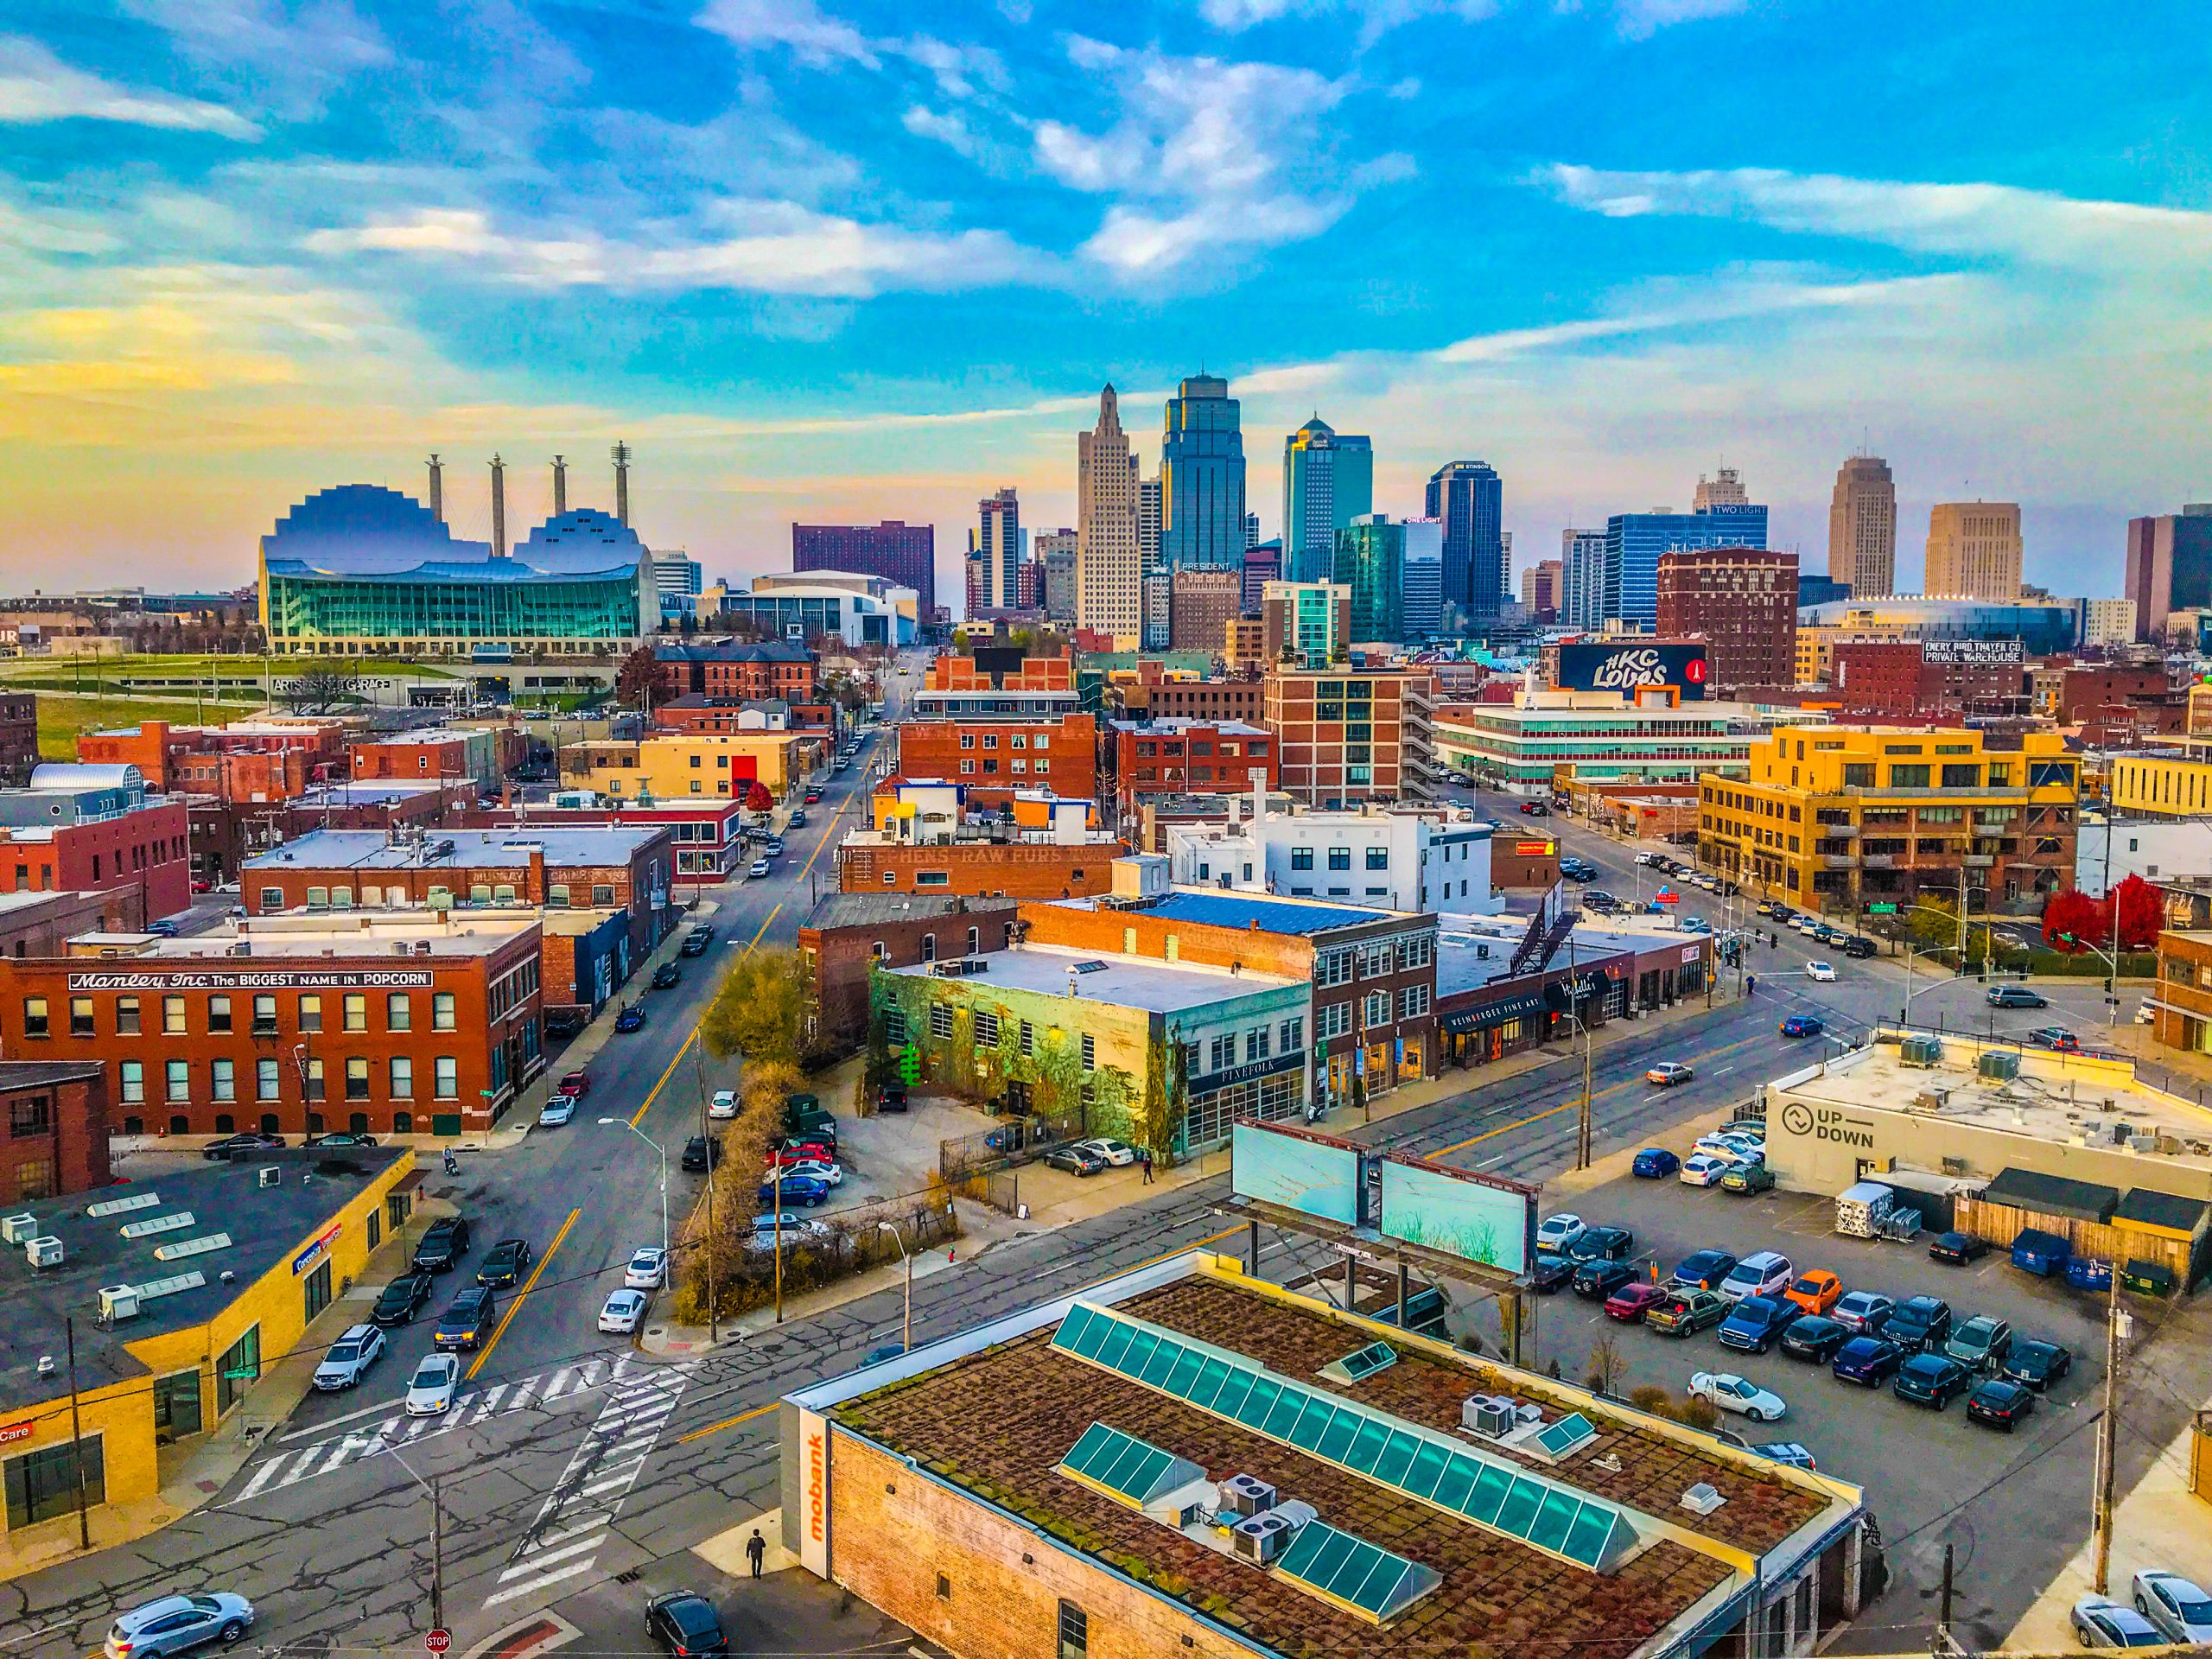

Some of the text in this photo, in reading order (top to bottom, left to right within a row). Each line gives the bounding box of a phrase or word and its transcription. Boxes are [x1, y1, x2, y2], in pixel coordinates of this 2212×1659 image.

[1715, 505, 1765, 514] TWO LIGHT
[1925, 642, 1950, 652] EMERY
[1974, 642, 2005, 652] THAYER
[1925, 652, 2020, 662] PRIVATE WAREHOUSE
[274, 679, 302, 690] ARTS
[346, 679, 389, 690] GARAGE
[962, 849, 1004, 862] RAW
[1013, 849, 1060, 862] FURS
[169, 973, 208, 987] Inc.
[212, 975, 235, 986] The
[240, 974, 294, 986] BIGGEST
[300, 976, 338, 985] NAME
[343, 976, 357, 985] IN
[363, 973, 427, 985] POPCORN
[1561, 976, 1596, 997] Mihelle's
[1451, 998, 1539, 1026] WEINBERGER FINE ART
[1222, 1060, 1274, 1082] FINEFOLK
[1817, 1109, 1842, 1124] UP
[1816, 1126, 1873, 1147] DOWN
[0, 1427, 29, 1441] Care
[808, 1433, 823, 1542] mobank
[427, 1637, 449, 1646] STOP
